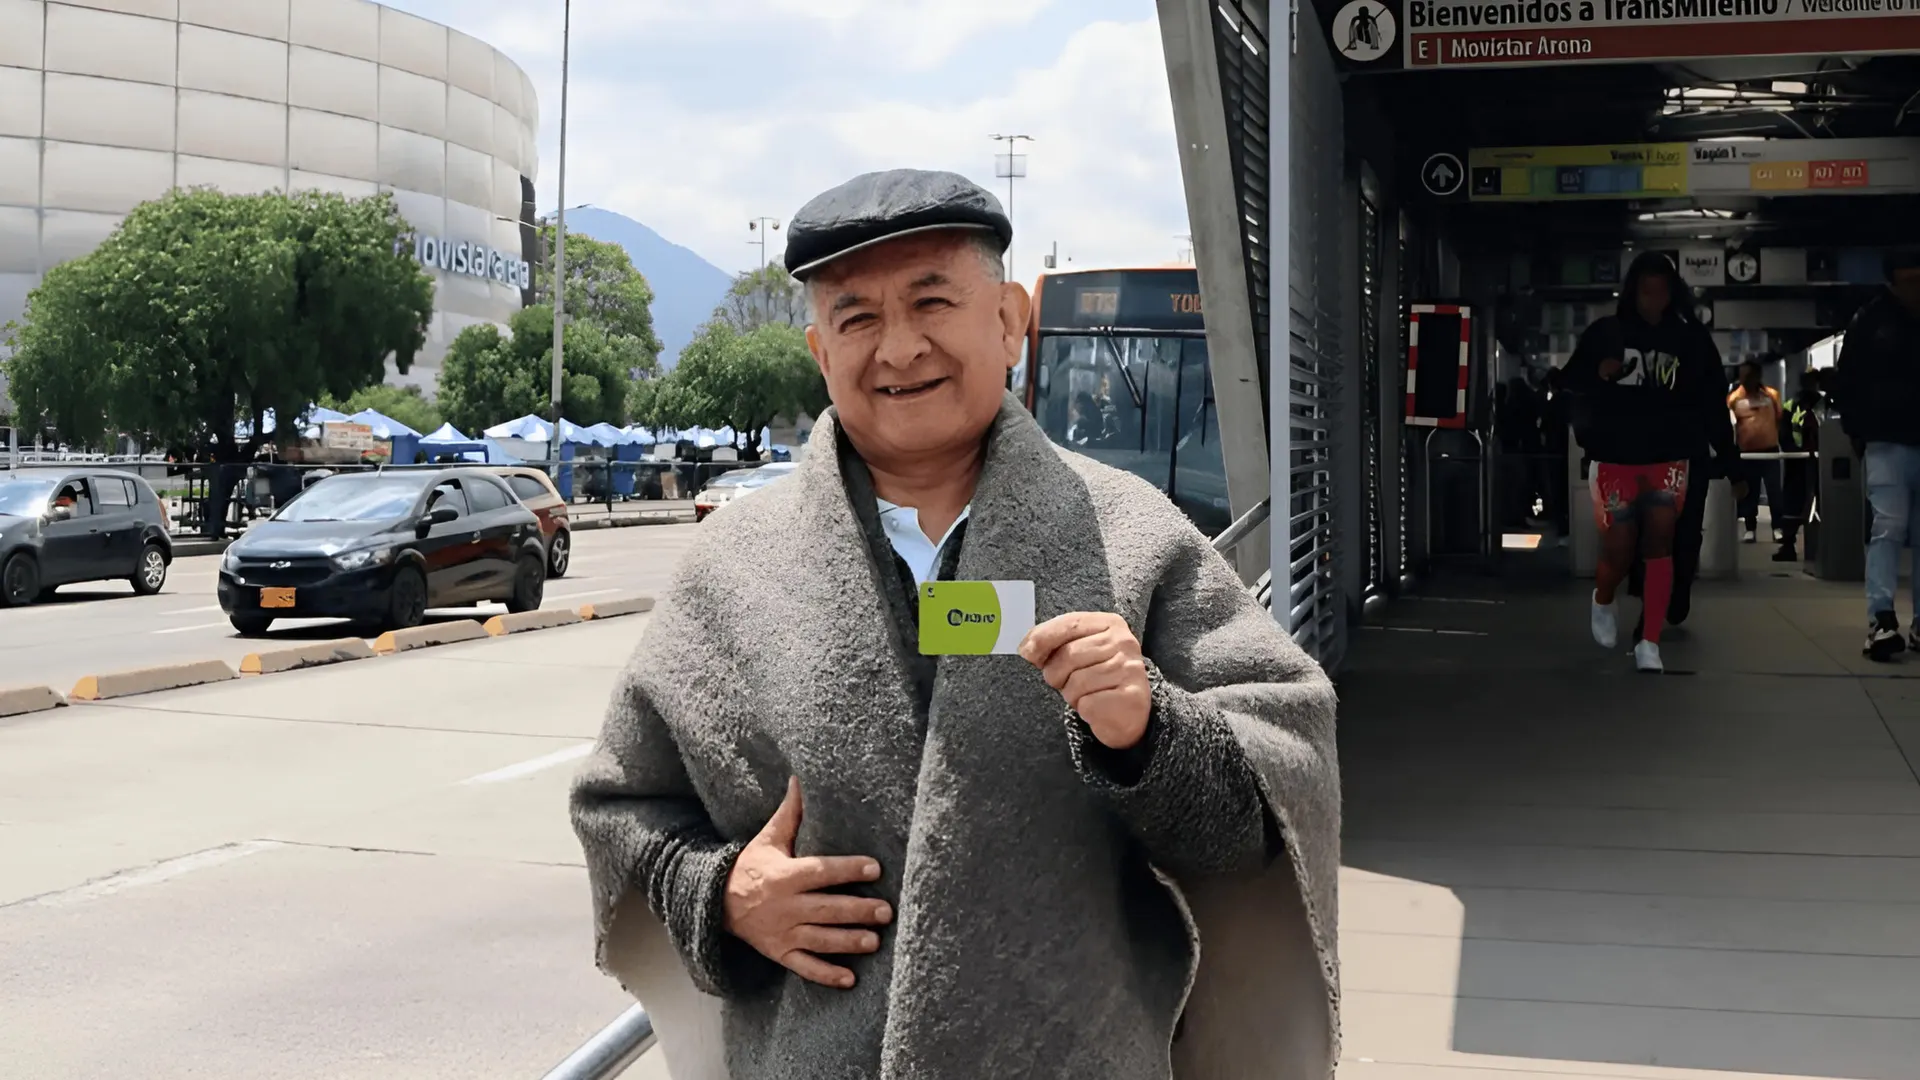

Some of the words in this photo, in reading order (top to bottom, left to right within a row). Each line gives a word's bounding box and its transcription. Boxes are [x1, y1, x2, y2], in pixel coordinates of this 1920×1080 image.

[1410, 0, 1571, 27] Bienvenidos
[1579, 1, 1594, 21] a
[1418, 40, 1428, 59] E
[1451, 37, 1534, 58] Movistar
